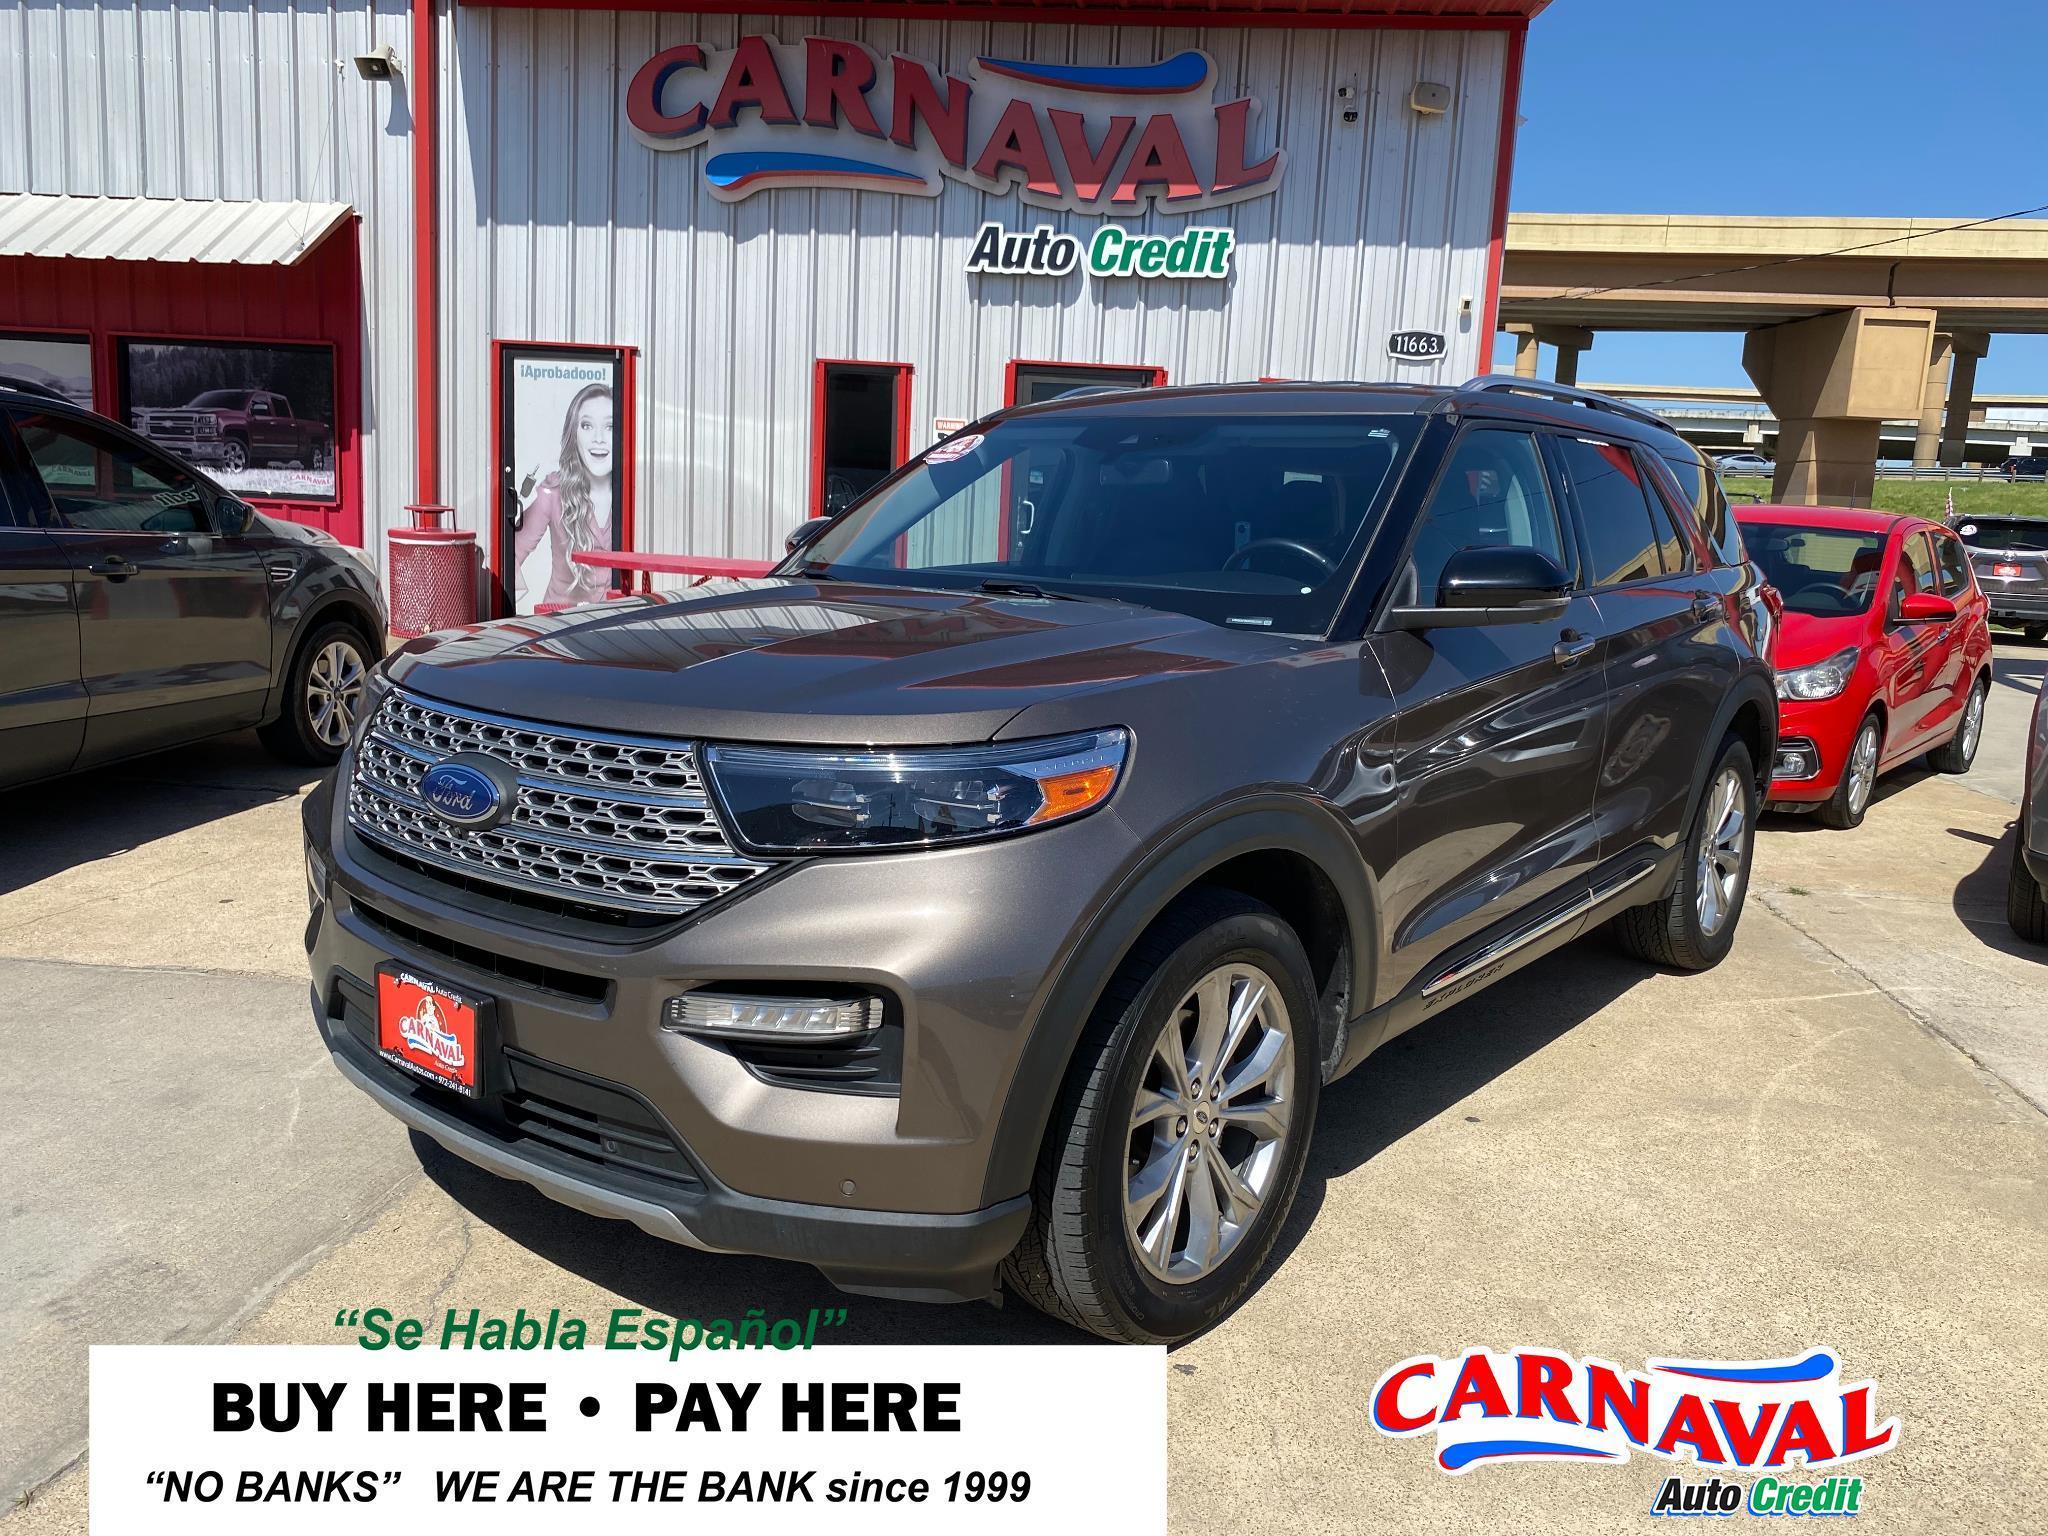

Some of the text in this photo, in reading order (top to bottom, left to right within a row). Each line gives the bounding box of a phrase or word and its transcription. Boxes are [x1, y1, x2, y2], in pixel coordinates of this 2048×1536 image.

[626, 34, 1280, 204] CARNAVAL
[967, 227, 1232, 275] Auto Credit
[1396, 336, 1438, 353] 11663
[290, 473, 331, 485] CARNAVAL
[432, 774, 477, 811] Ford
[400, 1016, 463, 1062] CARNAVAL
